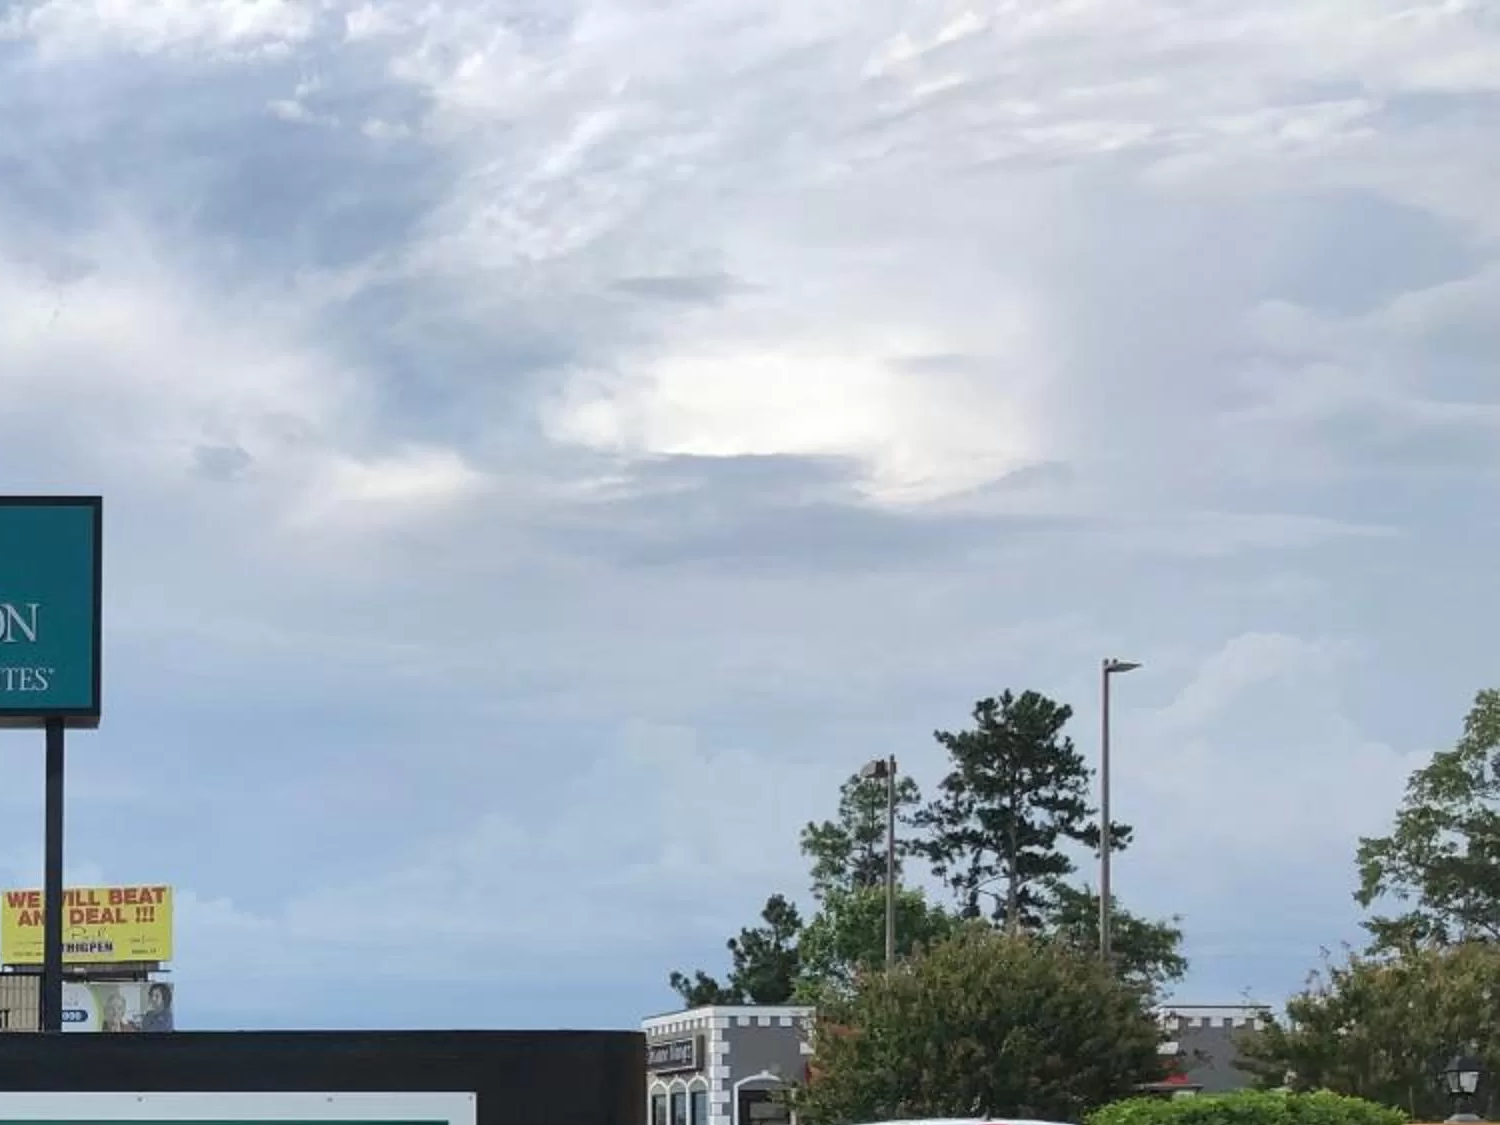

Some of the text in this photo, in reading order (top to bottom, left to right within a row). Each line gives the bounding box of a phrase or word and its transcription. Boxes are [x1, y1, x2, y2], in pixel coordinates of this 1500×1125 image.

[6, 886, 167, 908] WE ILL BEAT
[17, 906, 155, 927] AN DEAL !!!
[61, 941, 113, 954] HIGPEN
